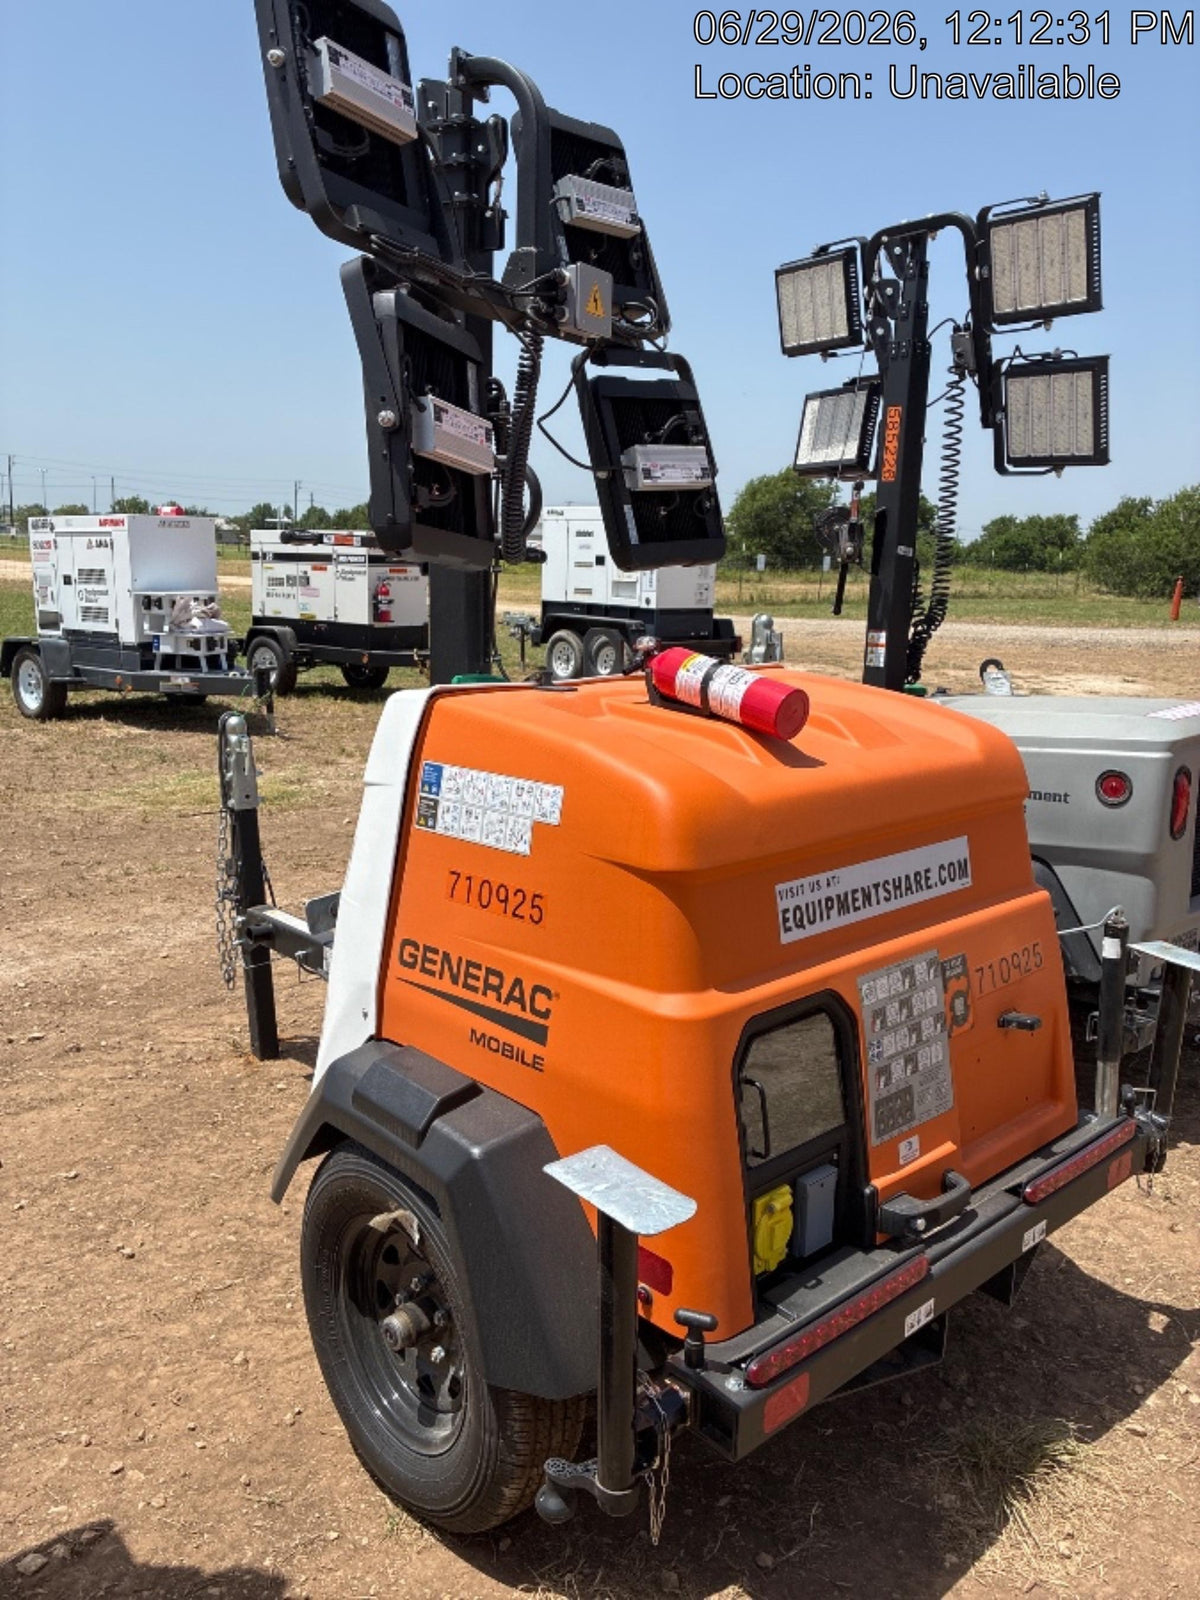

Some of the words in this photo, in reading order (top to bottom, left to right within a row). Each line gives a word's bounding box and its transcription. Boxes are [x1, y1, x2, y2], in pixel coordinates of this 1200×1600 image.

[448, 870, 545, 926] 710925
[778, 883, 805, 901] VISIT
[808, 879, 822, 894] US
[826, 875, 841, 888] AT:
[780, 856, 969, 934] EQUIPMENTSHARE.COM
[398, 937, 555, 1021] GENERAC
[975, 942, 1044, 995] 710925
[469, 1028, 546, 1073] MOBILE
